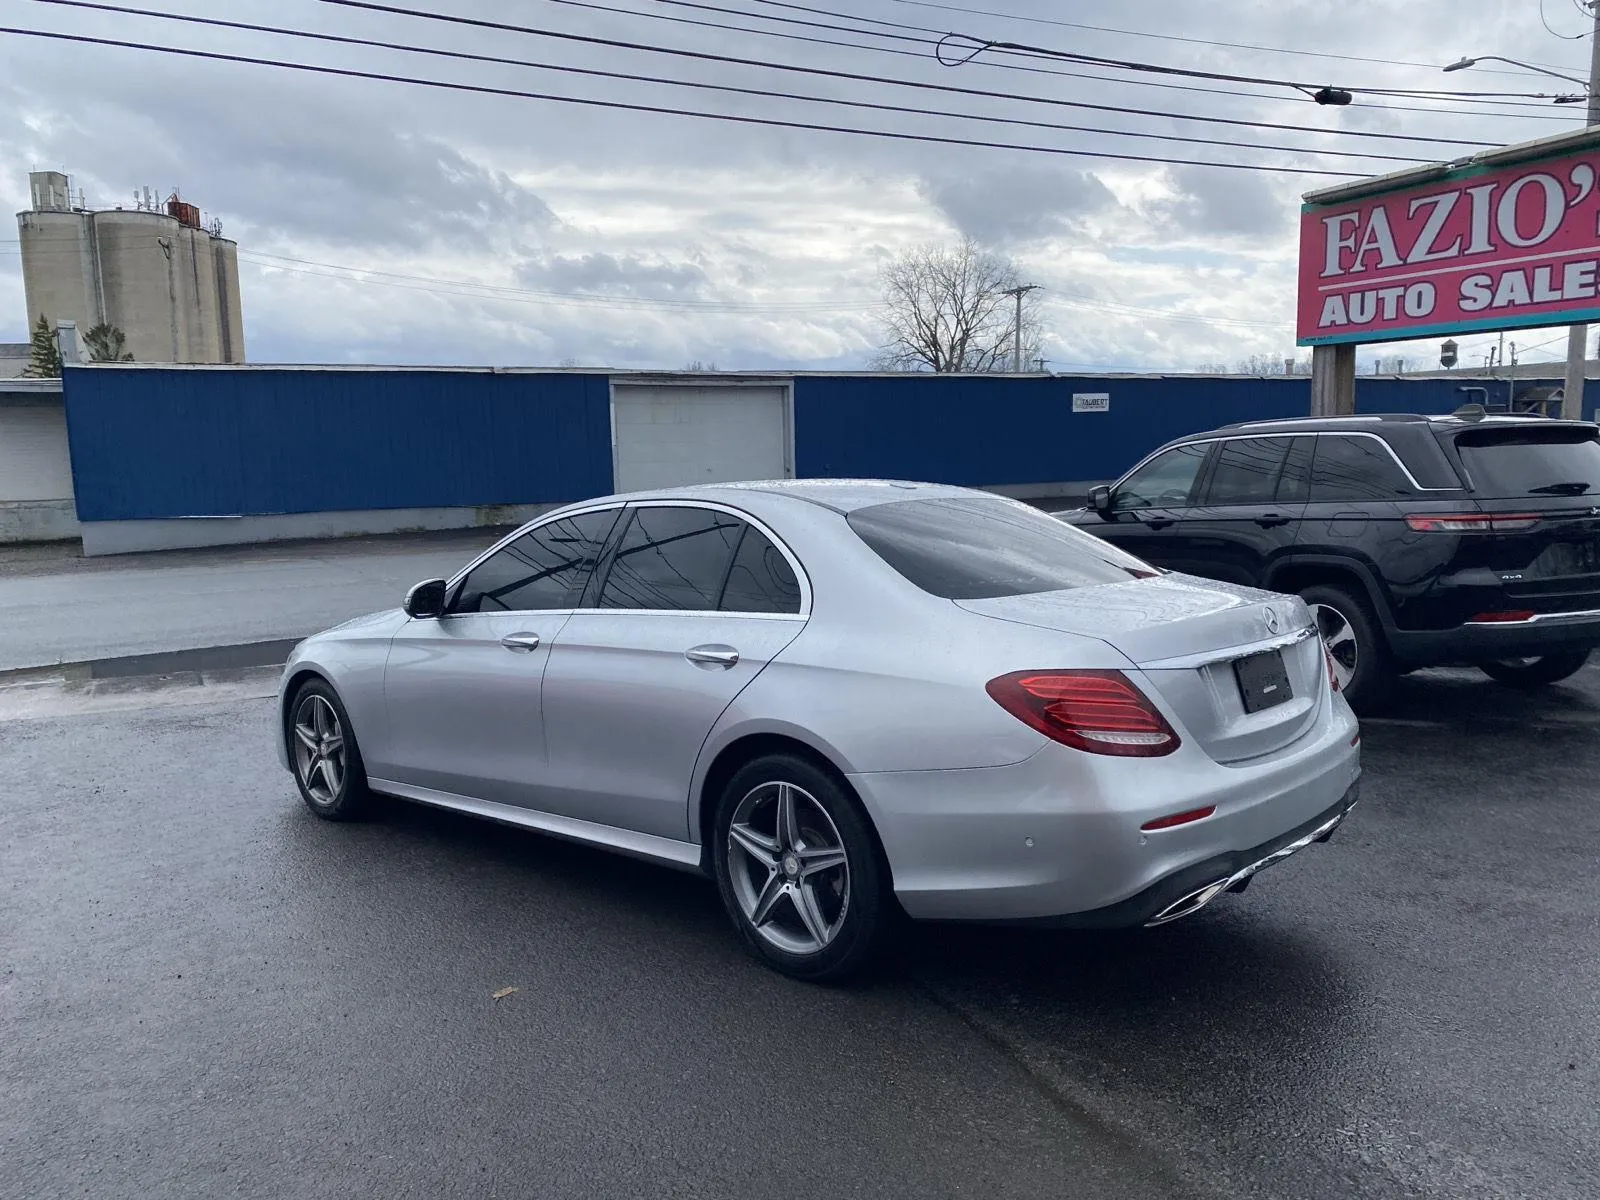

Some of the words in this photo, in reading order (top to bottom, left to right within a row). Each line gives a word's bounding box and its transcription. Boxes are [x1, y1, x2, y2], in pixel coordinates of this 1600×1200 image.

[1319, 163, 1600, 278] FAZIO'
[1318, 281, 1436, 328] AUTO
[1459, 260, 1600, 312] SALE
